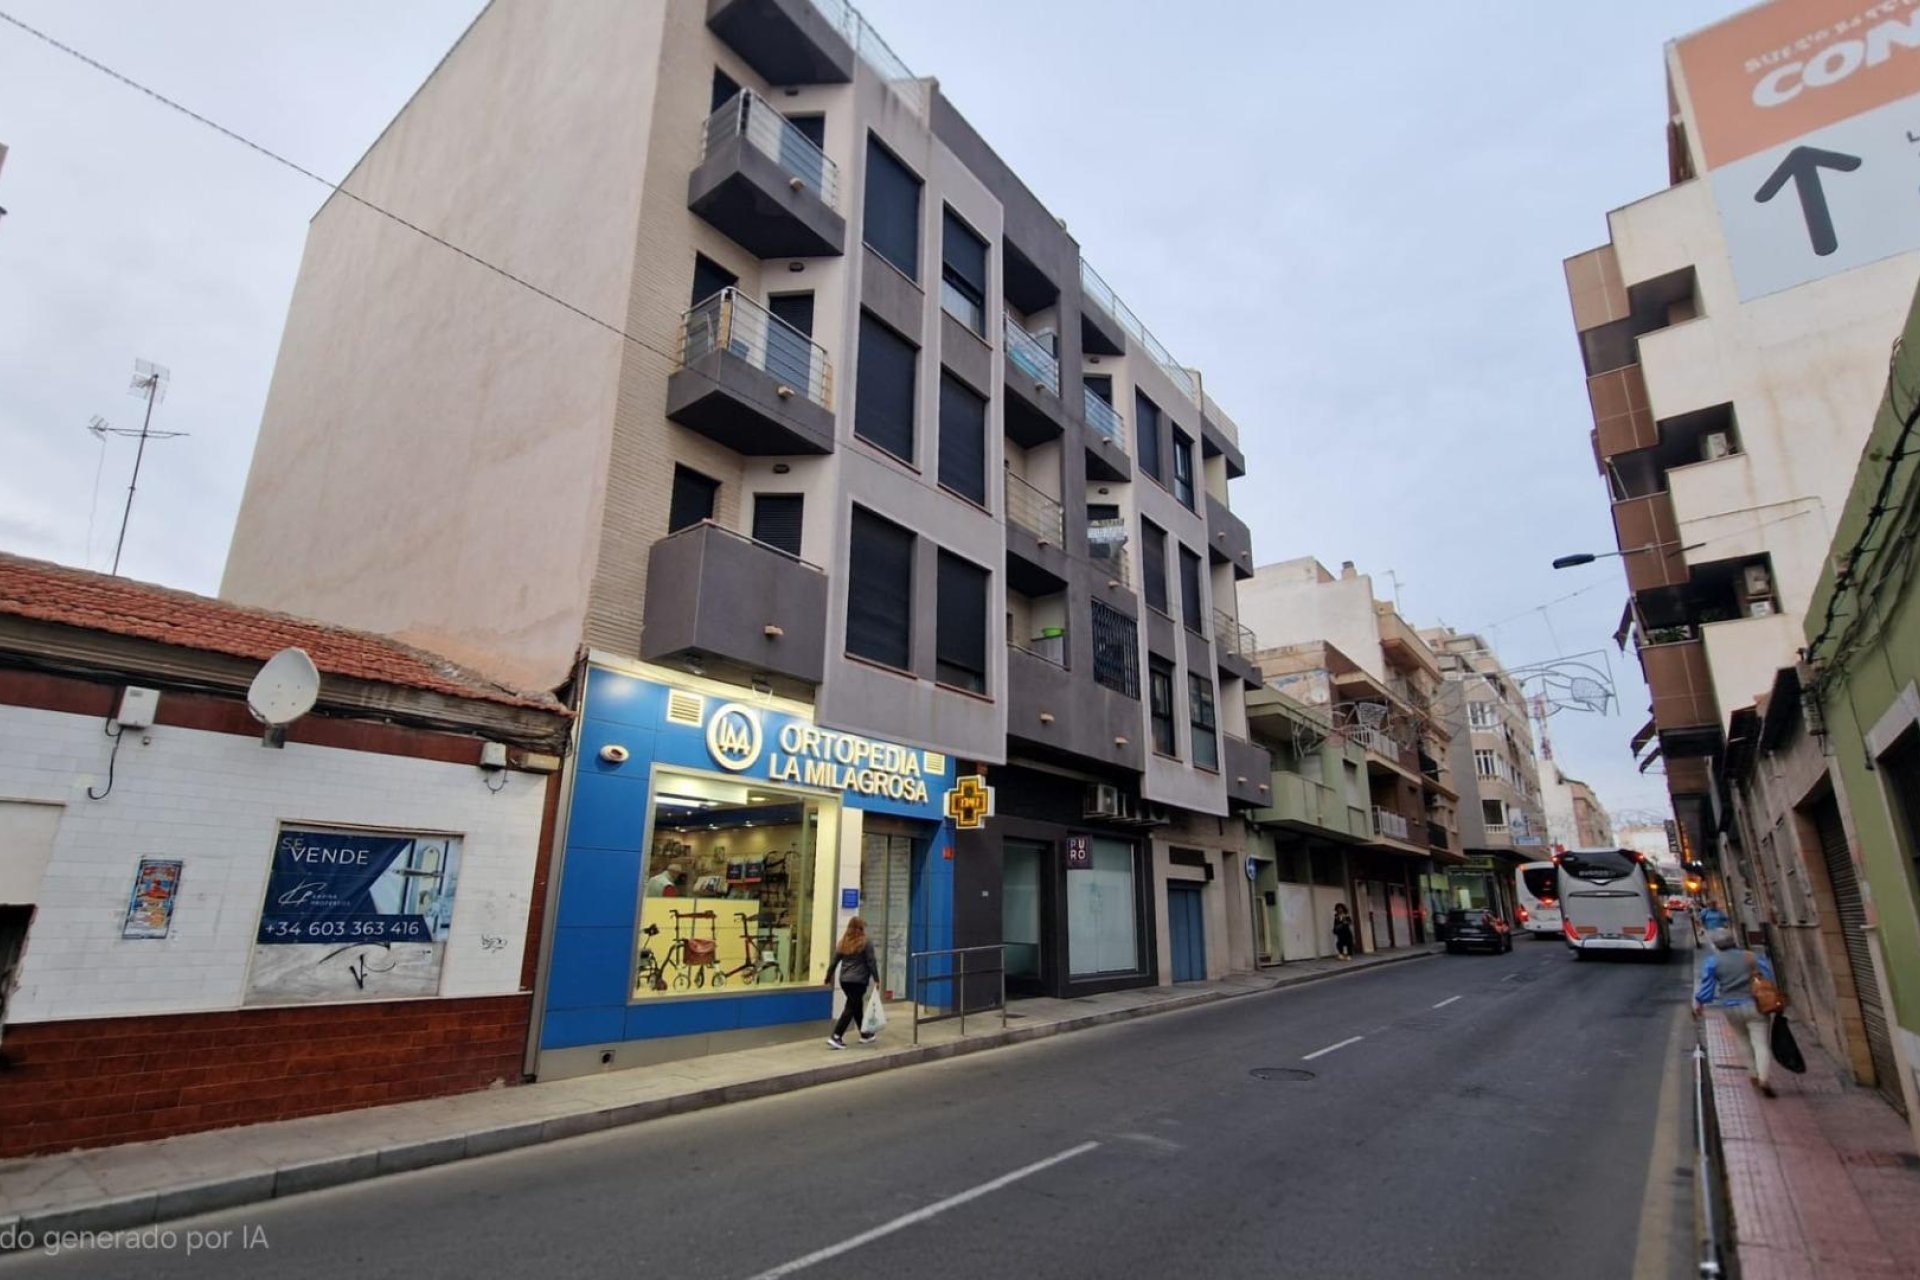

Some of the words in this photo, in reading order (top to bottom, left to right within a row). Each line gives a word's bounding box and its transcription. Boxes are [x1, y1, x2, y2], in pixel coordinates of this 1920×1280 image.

[780, 723, 920, 778] ORTOPEDIA
[769, 752, 800, 783] LA
[804, 759, 929, 804] MILAGROSA
[281, 837, 304, 850] SE
[291, 846, 370, 865] VENDE
[265, 921, 301, 936] +34
[308, 921, 345, 936] 603
[351, 921, 385, 936] 363
[390, 921, 419, 936] 416
